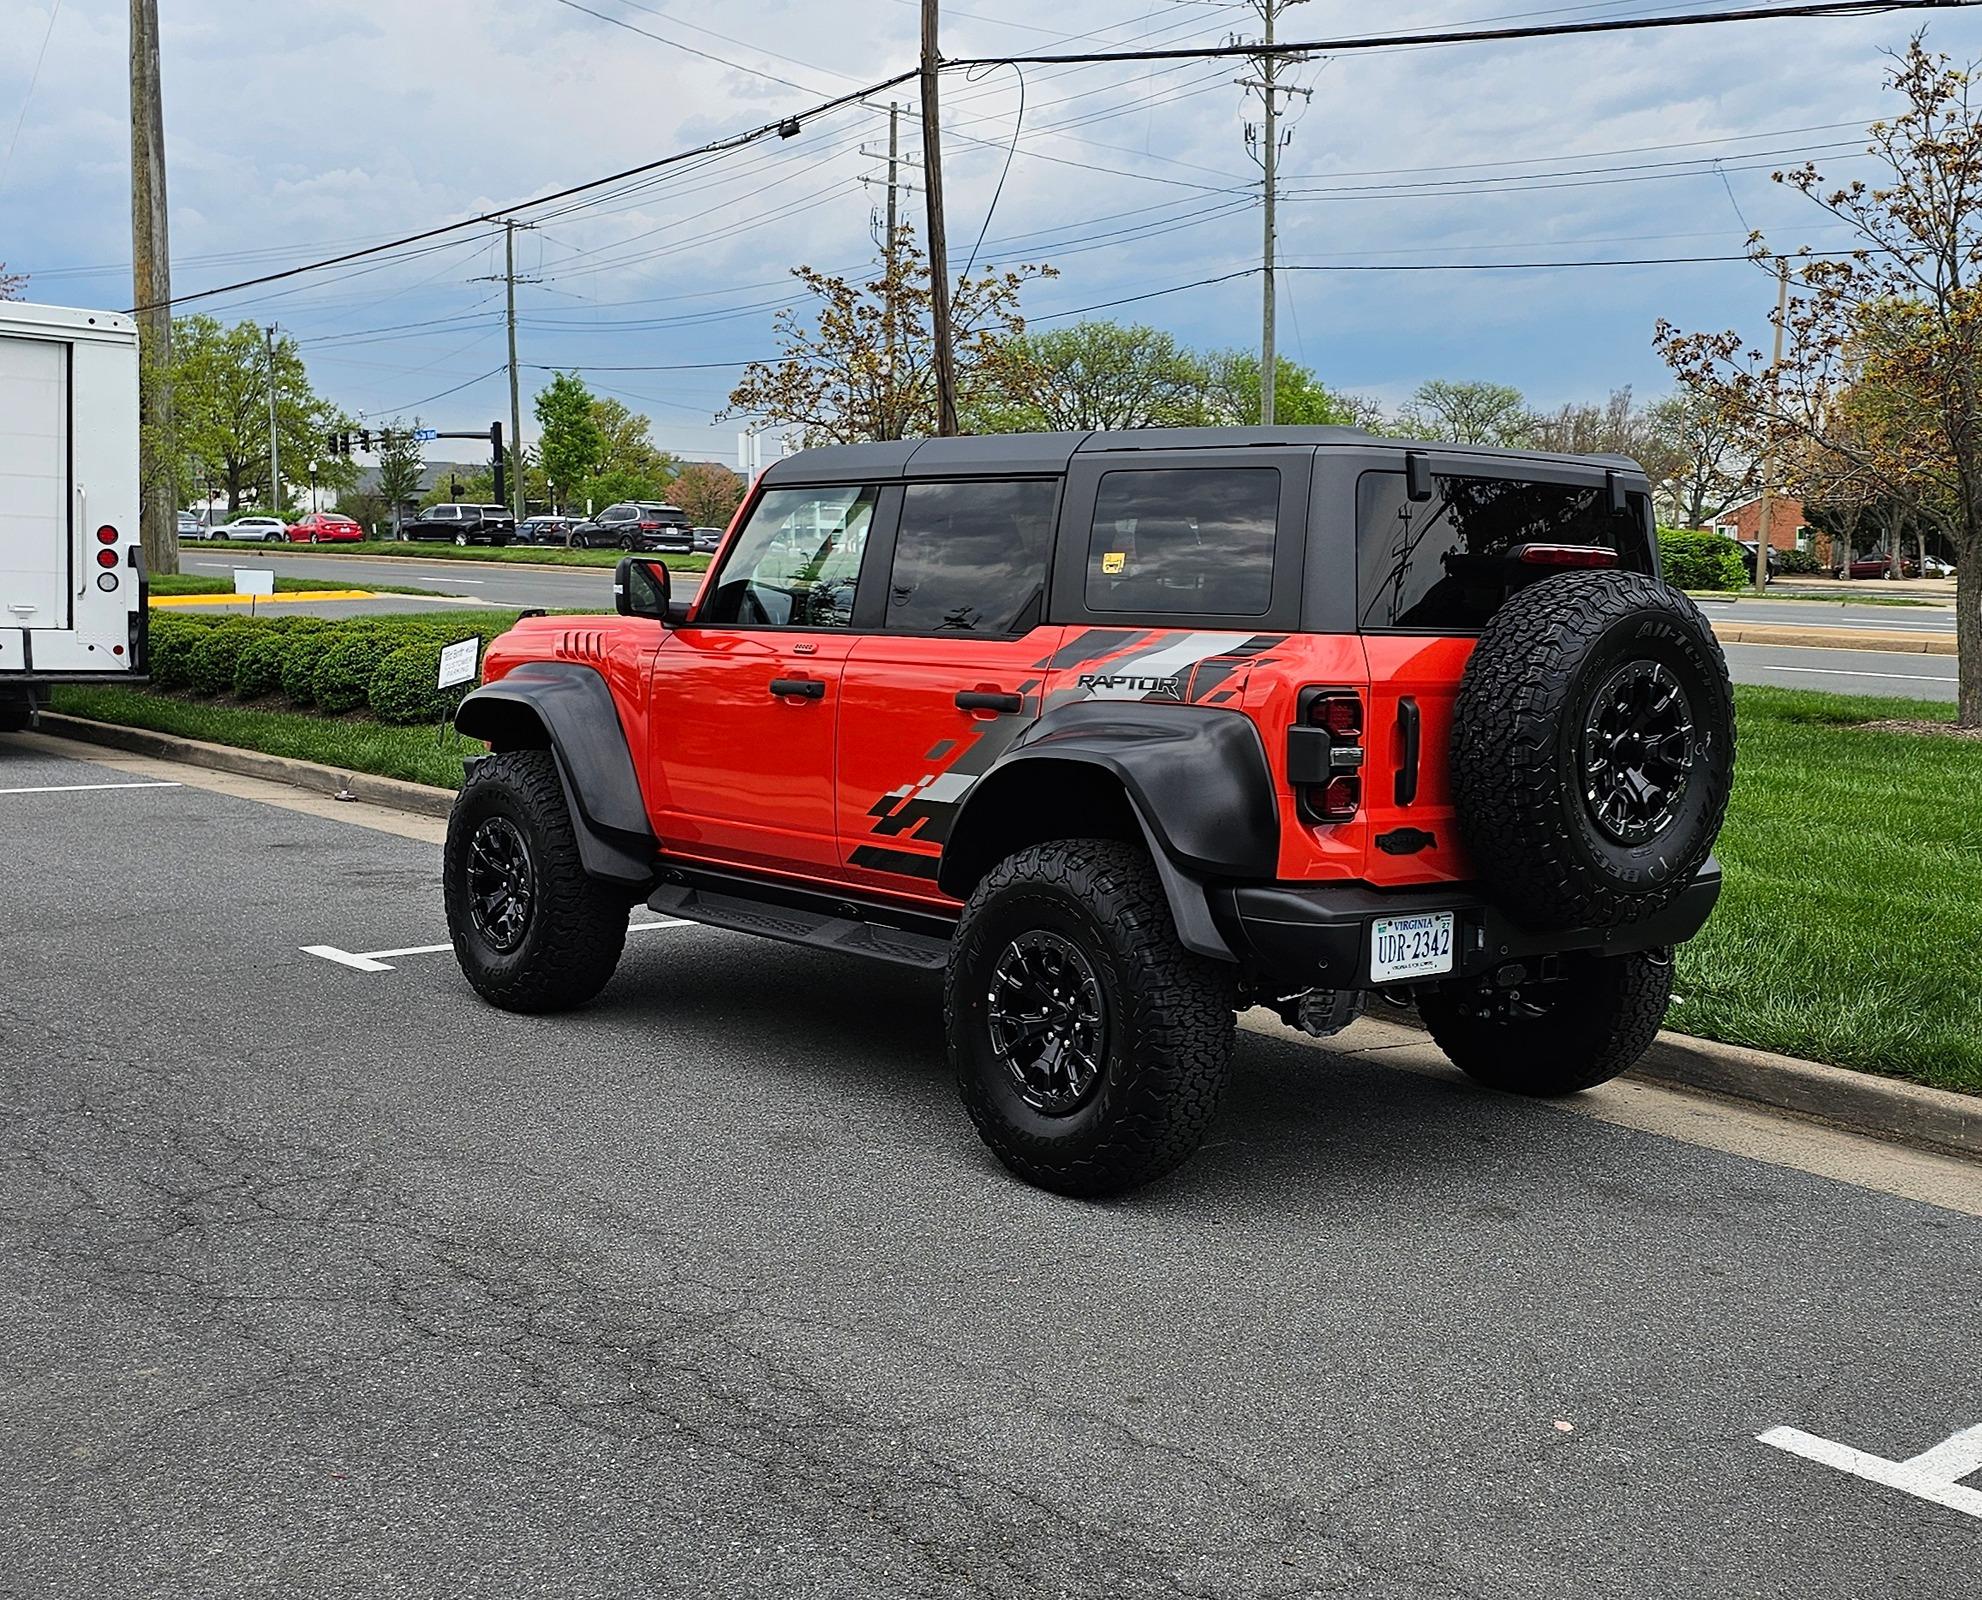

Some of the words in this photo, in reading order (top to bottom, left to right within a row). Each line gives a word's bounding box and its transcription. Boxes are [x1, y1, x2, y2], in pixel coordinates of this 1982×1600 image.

[1077, 674, 1180, 700] RAPTOR
[1394, 918, 1433, 931] VIRGINIA
[1379, 929, 1449, 963] UDR-2342
